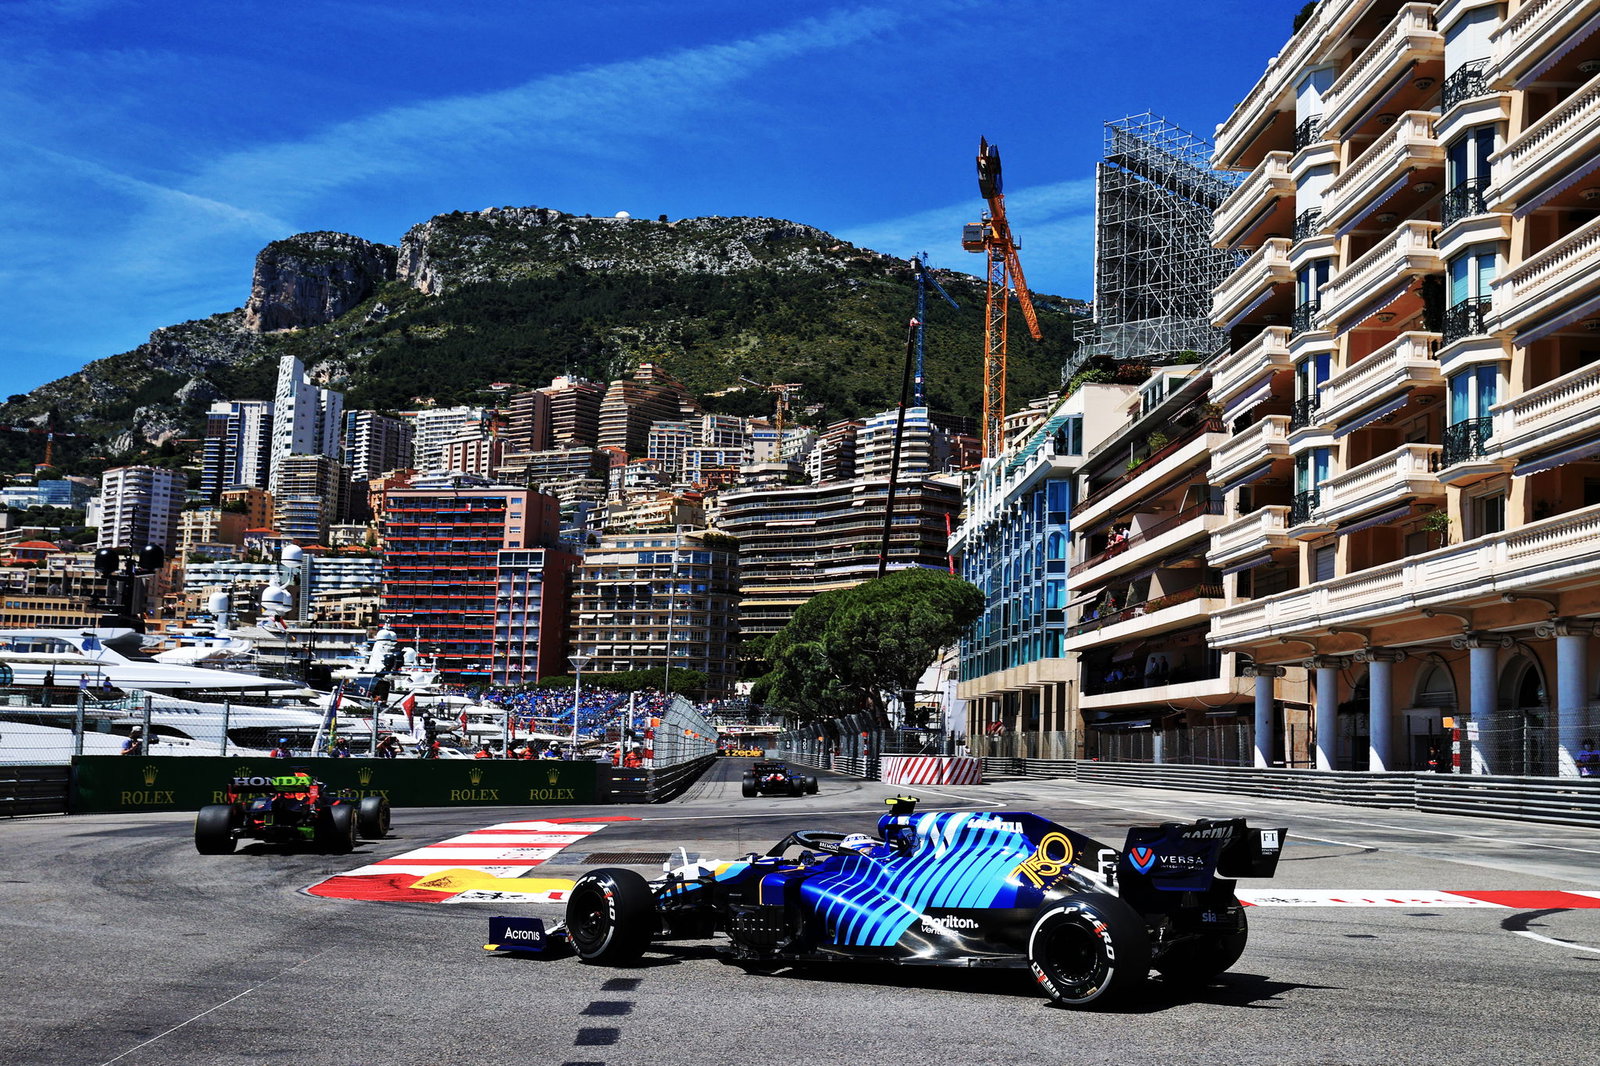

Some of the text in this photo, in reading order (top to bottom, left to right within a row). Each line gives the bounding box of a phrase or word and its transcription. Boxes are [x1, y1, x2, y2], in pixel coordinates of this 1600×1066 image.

[233, 776, 313, 786] HONDA
[121, 790, 175, 805] ROLEX
[450, 789, 499, 801] ROLEX
[529, 788, 575, 800] ROLEX
[1263, 832, 1277, 842] FT
[1159, 855, 1204, 865] VERSA
[597, 879, 615, 921] ZERO
[504, 926, 541, 941] Acronis
[1063, 906, 1115, 960] P ZERO
